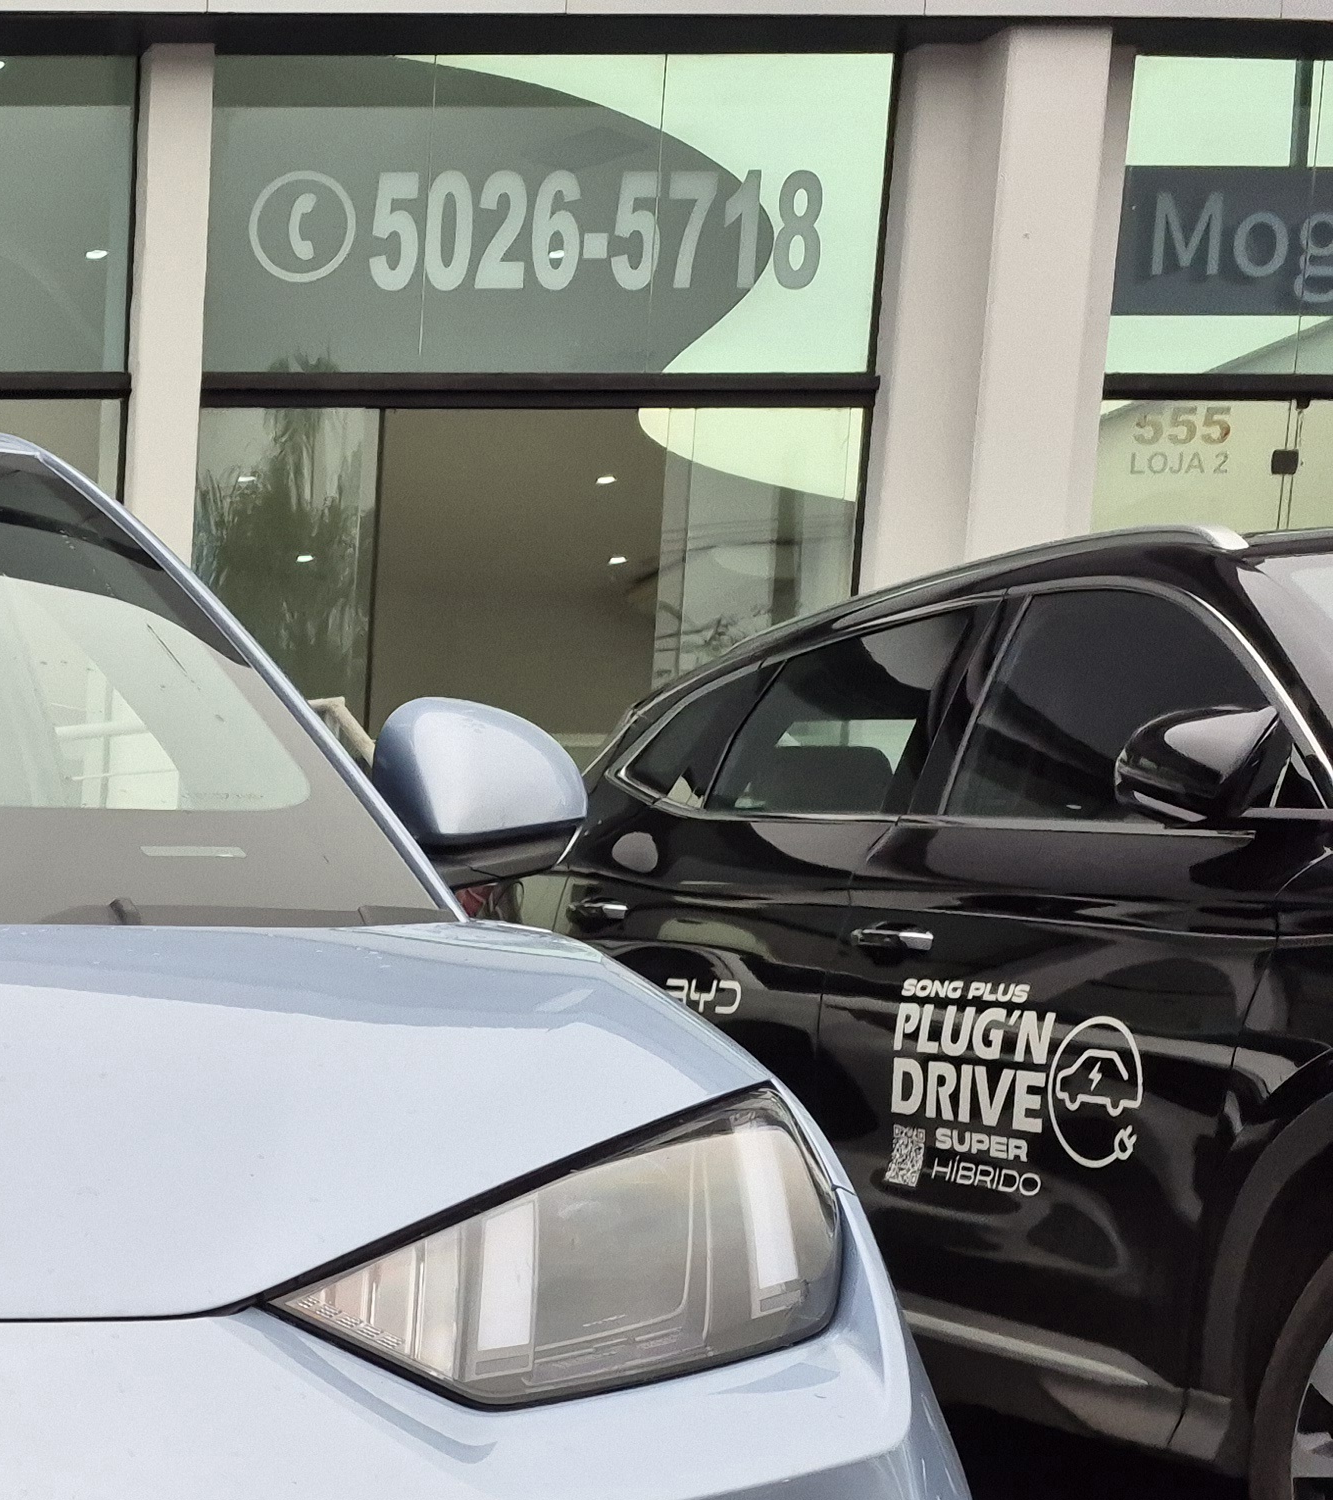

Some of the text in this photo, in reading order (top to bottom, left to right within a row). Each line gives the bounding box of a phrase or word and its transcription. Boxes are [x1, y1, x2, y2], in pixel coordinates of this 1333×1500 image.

[368, 169, 822, 291] 5026-5718
[1133, 406, 1231, 445] 555
[1130, 452, 1228, 474] LOJA 2
[666, 977, 741, 1014] BYD
[901, 978, 1031, 1003] SONG PLUS
[893, 1002, 1057, 1064] PLUG'N
[891, 1057, 1047, 1133] DRIVE
[935, 1127, 1028, 1162] SUPER
[931, 1155, 1042, 1196] HÍBRIDO
